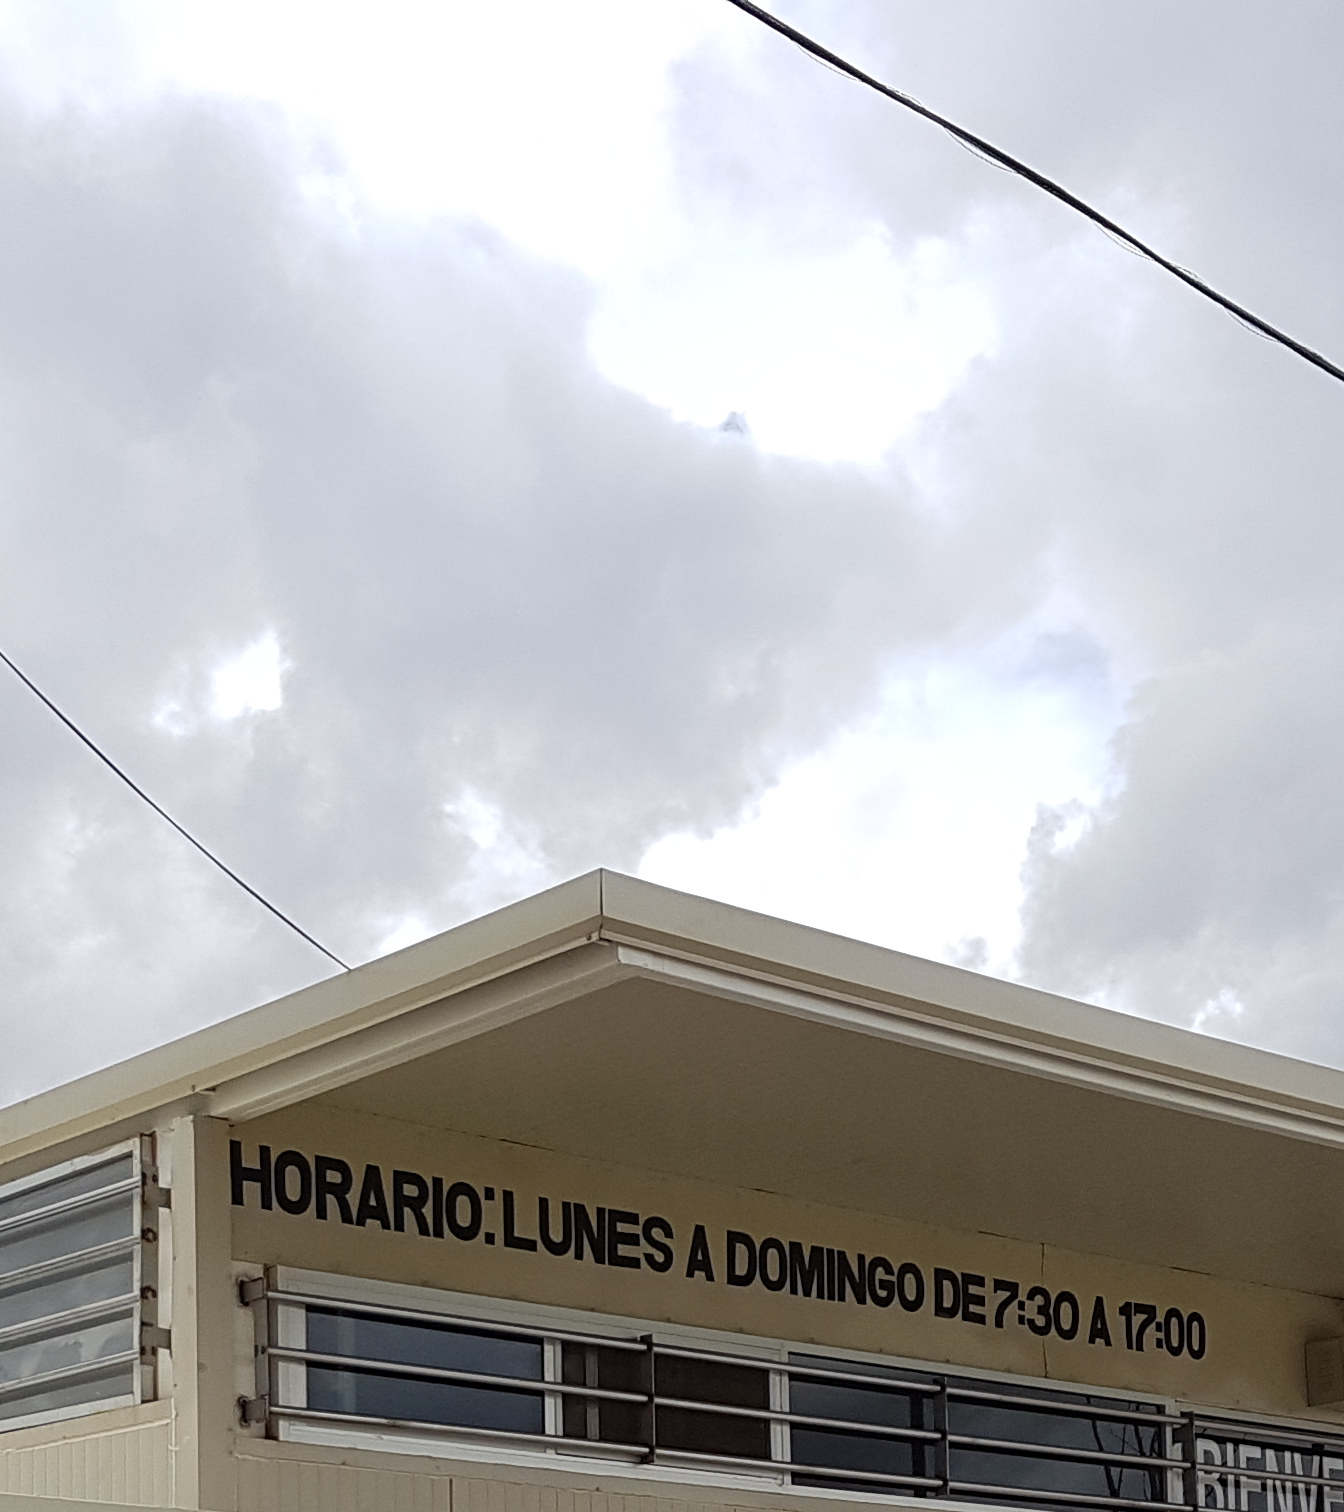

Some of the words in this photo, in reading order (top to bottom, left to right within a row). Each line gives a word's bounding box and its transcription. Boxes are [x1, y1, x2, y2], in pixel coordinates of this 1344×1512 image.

[229, 1138, 496, 1246] HORARIO:
[502, 1189, 674, 1274] LUNES
[685, 1223, 715, 1283] A
[726, 1229, 925, 1312] DOMINGO
[934, 1266, 987, 1327] DE
[992, 1277, 1080, 1341] 7:30
[1087, 1295, 1113, 1348] A
[1118, 1300, 1207, 1361] 17:00
